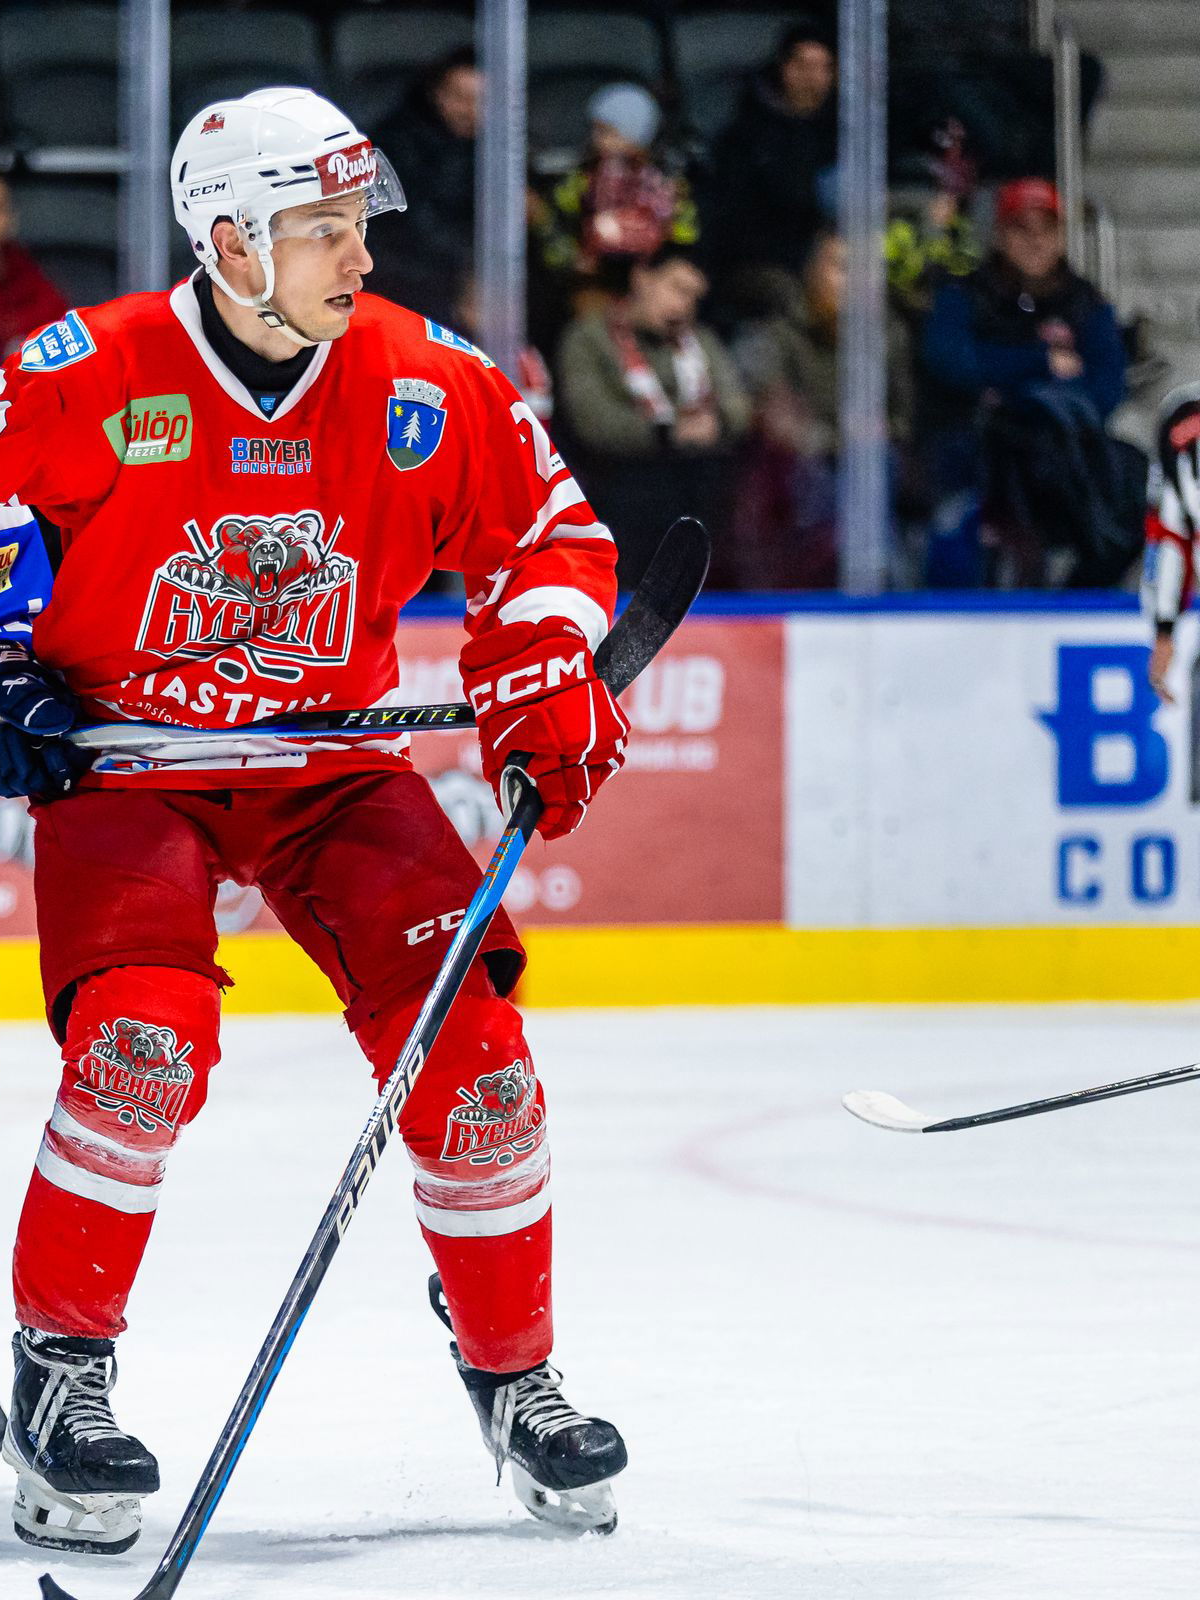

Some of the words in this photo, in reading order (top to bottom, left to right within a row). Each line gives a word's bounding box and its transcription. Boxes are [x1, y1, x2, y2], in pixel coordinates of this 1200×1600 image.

[327, 147, 377, 184] Rusty
[189, 181, 228, 198] CCM
[42, 334, 62, 360] LIGA
[230, 437, 312, 463] BAYER
[231, 461, 312, 475] CONSTRUCT
[469, 651, 588, 718] CCM
[342, 707, 461, 727] FLYLITE
[403, 907, 468, 946] CC
[28, 1430, 54, 1468] BAER
